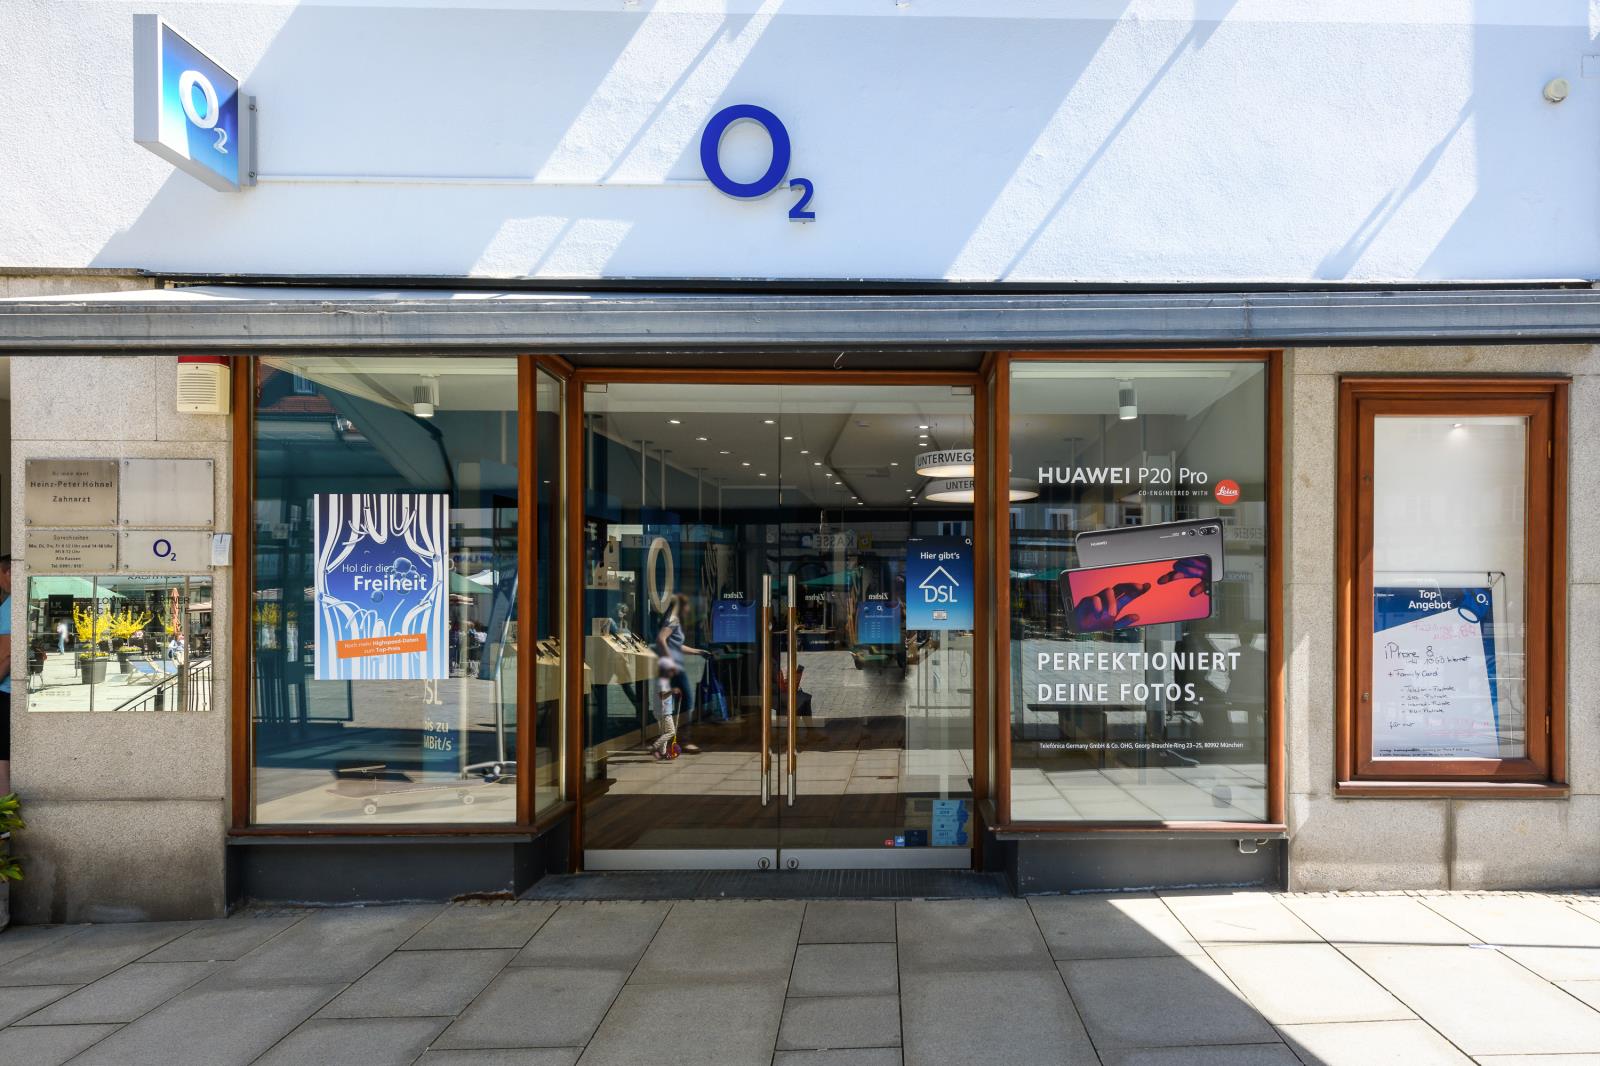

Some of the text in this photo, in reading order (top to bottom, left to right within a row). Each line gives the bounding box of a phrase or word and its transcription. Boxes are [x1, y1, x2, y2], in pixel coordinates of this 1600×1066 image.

[1038, 467, 1208, 484] HUAWEI P20 Pro
[1216, 486, 1240, 497] Leica
[920, 552, 936, 560] Hier
[342, 564, 388, 573] Hol dir die
[354, 575, 427, 591] Freiheit
[924, 585, 958, 603] DSL
[1418, 589, 1441, 601] Top-
[1408, 600, 1452, 612] Angebot
[1384, 641, 1434, 660] iPhone 8
[1037, 653, 1241, 671] PERFEKTIONIERT
[1037, 683, 1204, 702] DEINE FOTOS.
[435, 722, 449, 733] zu
[1066, 742, 1088, 750] Germany
[1120, 742, 1133, 750] OHG,
[1134, 742, 1185, 750] Georg-Brauchle-Ring
